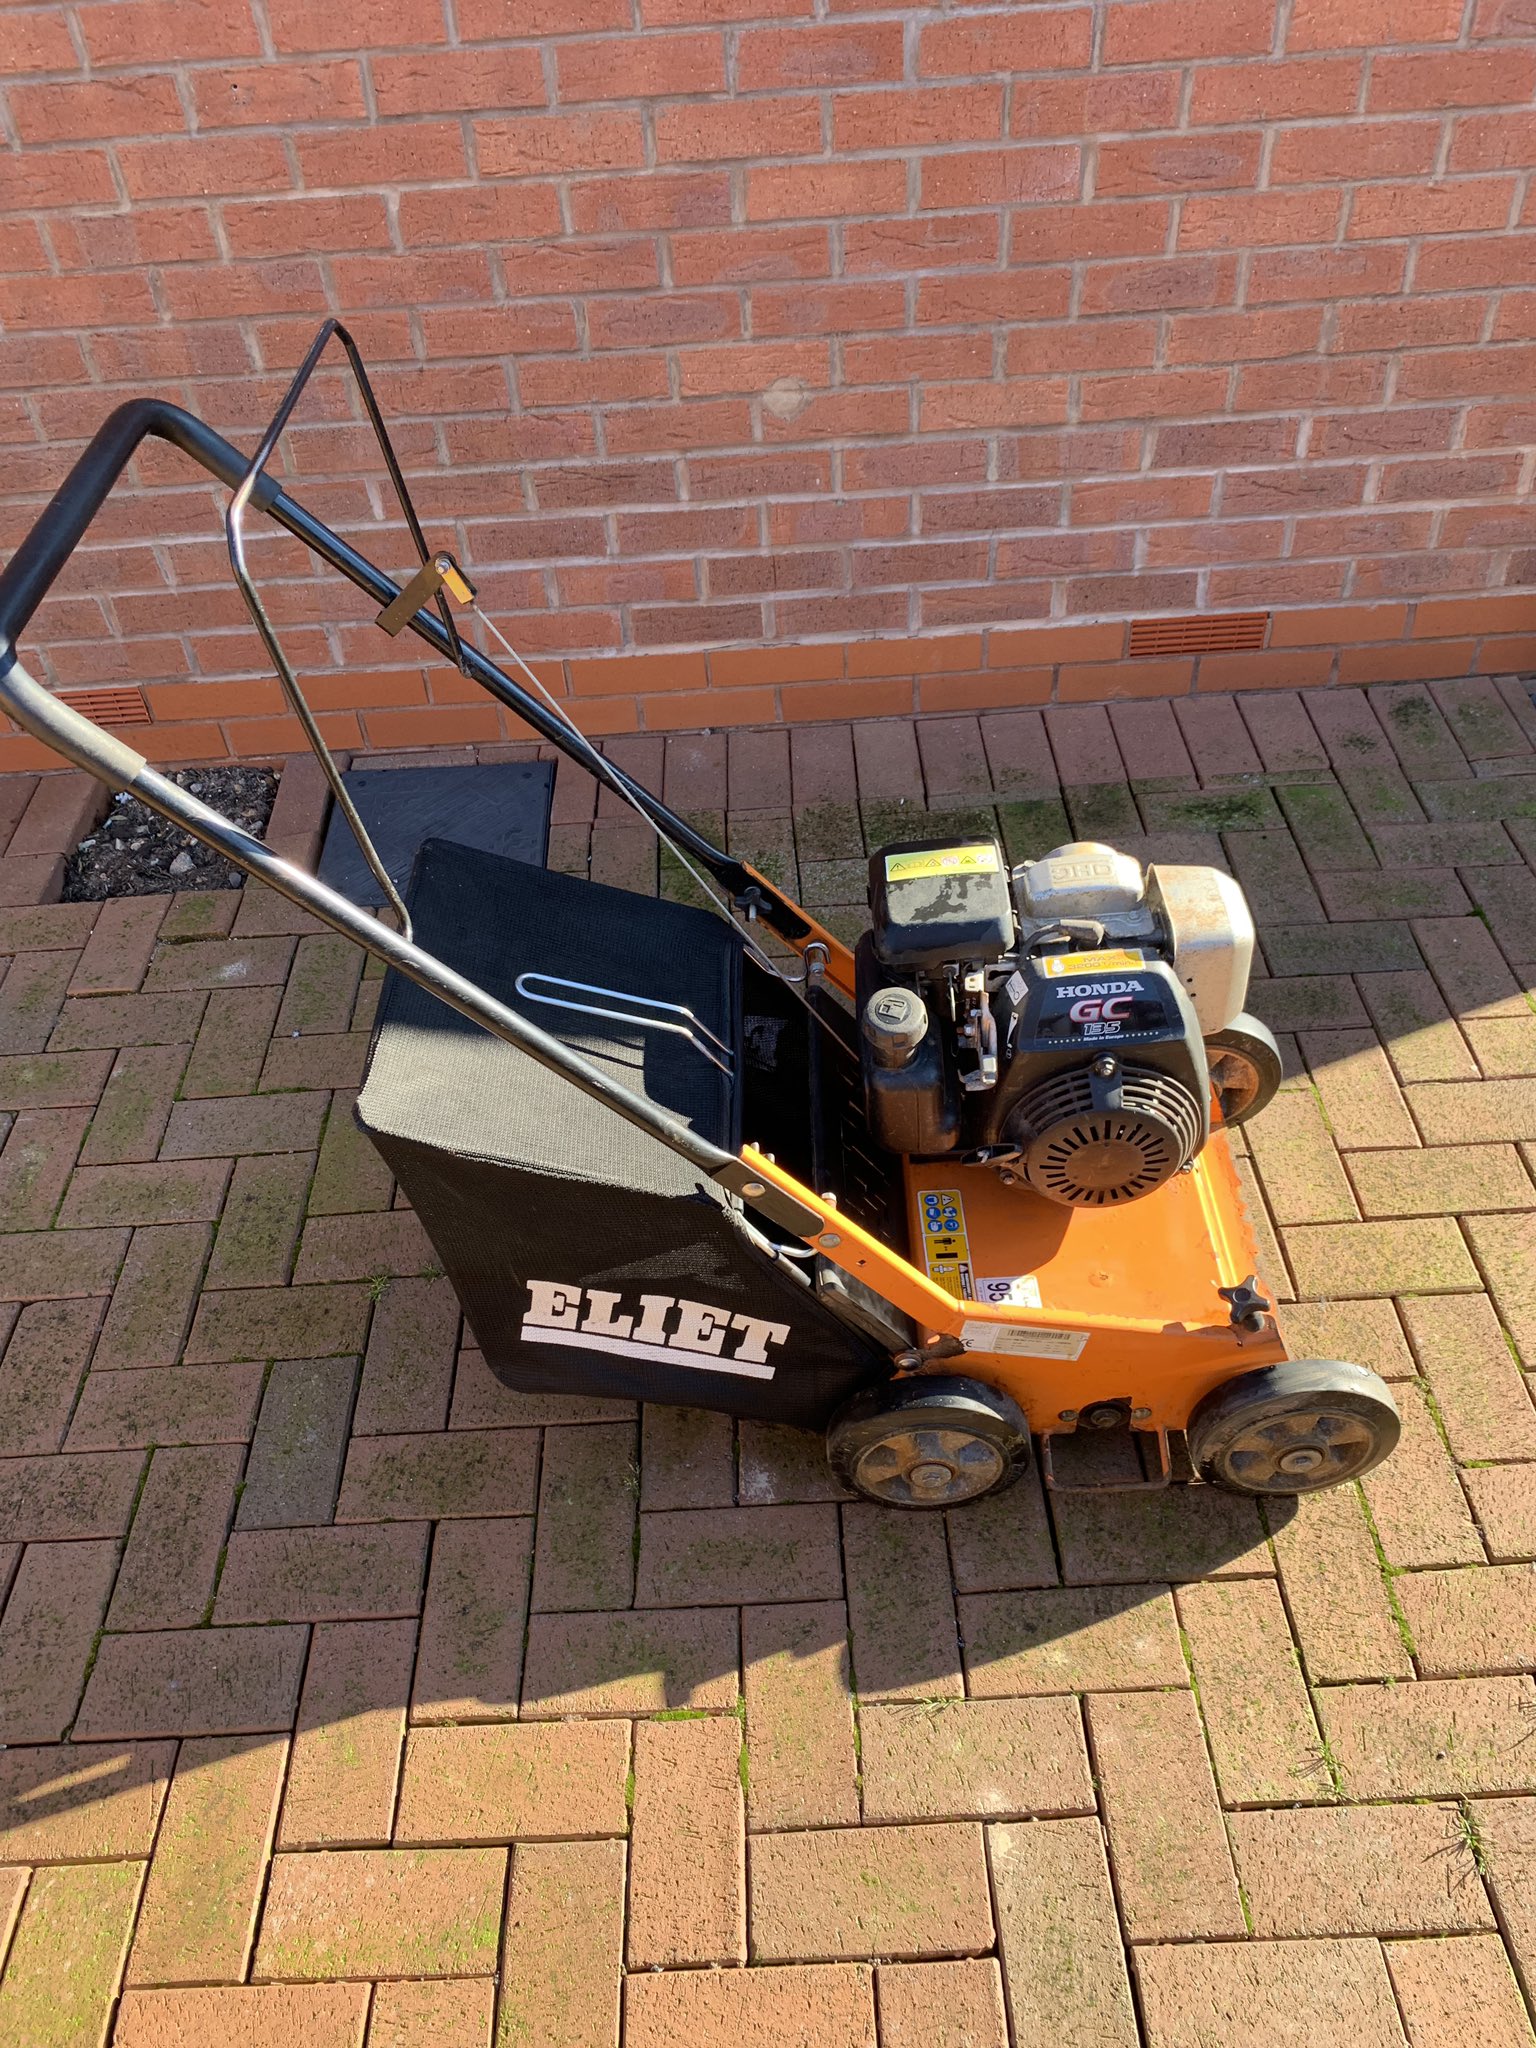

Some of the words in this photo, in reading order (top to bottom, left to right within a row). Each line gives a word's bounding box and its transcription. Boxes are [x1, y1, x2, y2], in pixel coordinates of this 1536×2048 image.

[1056, 980, 1144, 998] HONDA
[1069, 996, 1134, 1023] GC
[1084, 1021, 1121, 1035] 135
[987, 1282, 1013, 1302] 95
[522, 1280, 791, 1364] ELIET
